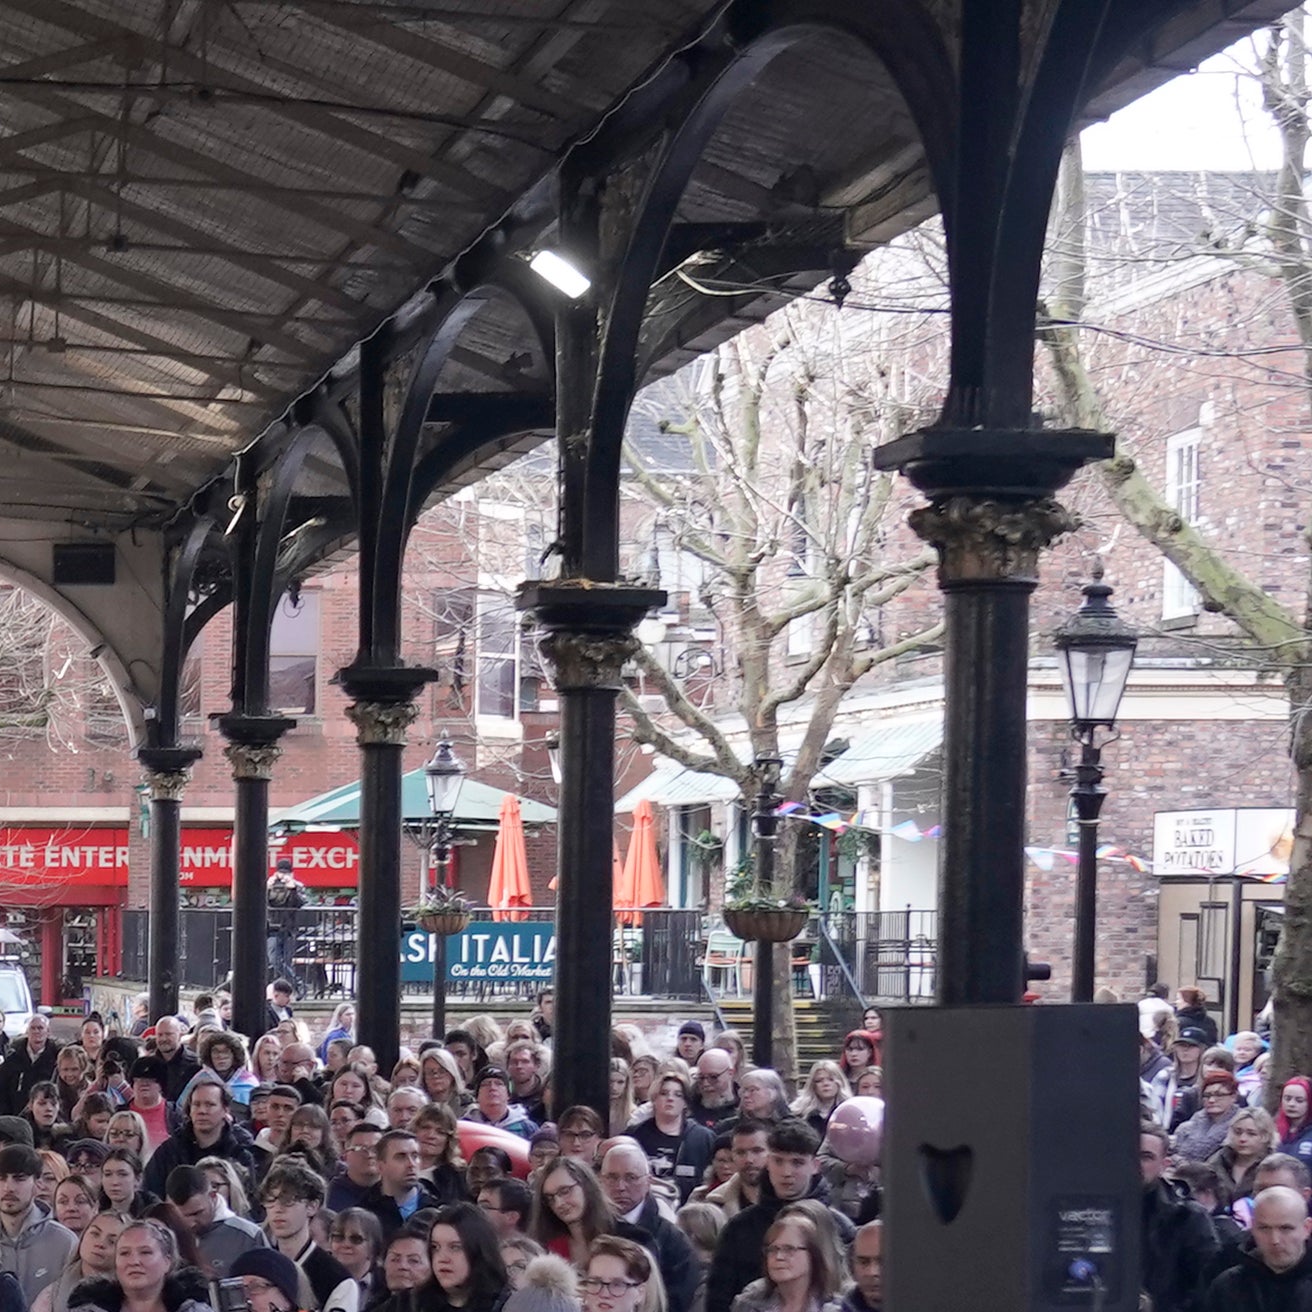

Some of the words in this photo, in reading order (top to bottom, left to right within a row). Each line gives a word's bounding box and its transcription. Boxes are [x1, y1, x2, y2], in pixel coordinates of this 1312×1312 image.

[1175, 829, 1214, 848] BAKED
[461, 934, 557, 963] ITALIA
[451, 963, 469, 977] On
[470, 964, 486, 977] the
[487, 963, 508, 977] Old
[510, 963, 552, 977] Market
